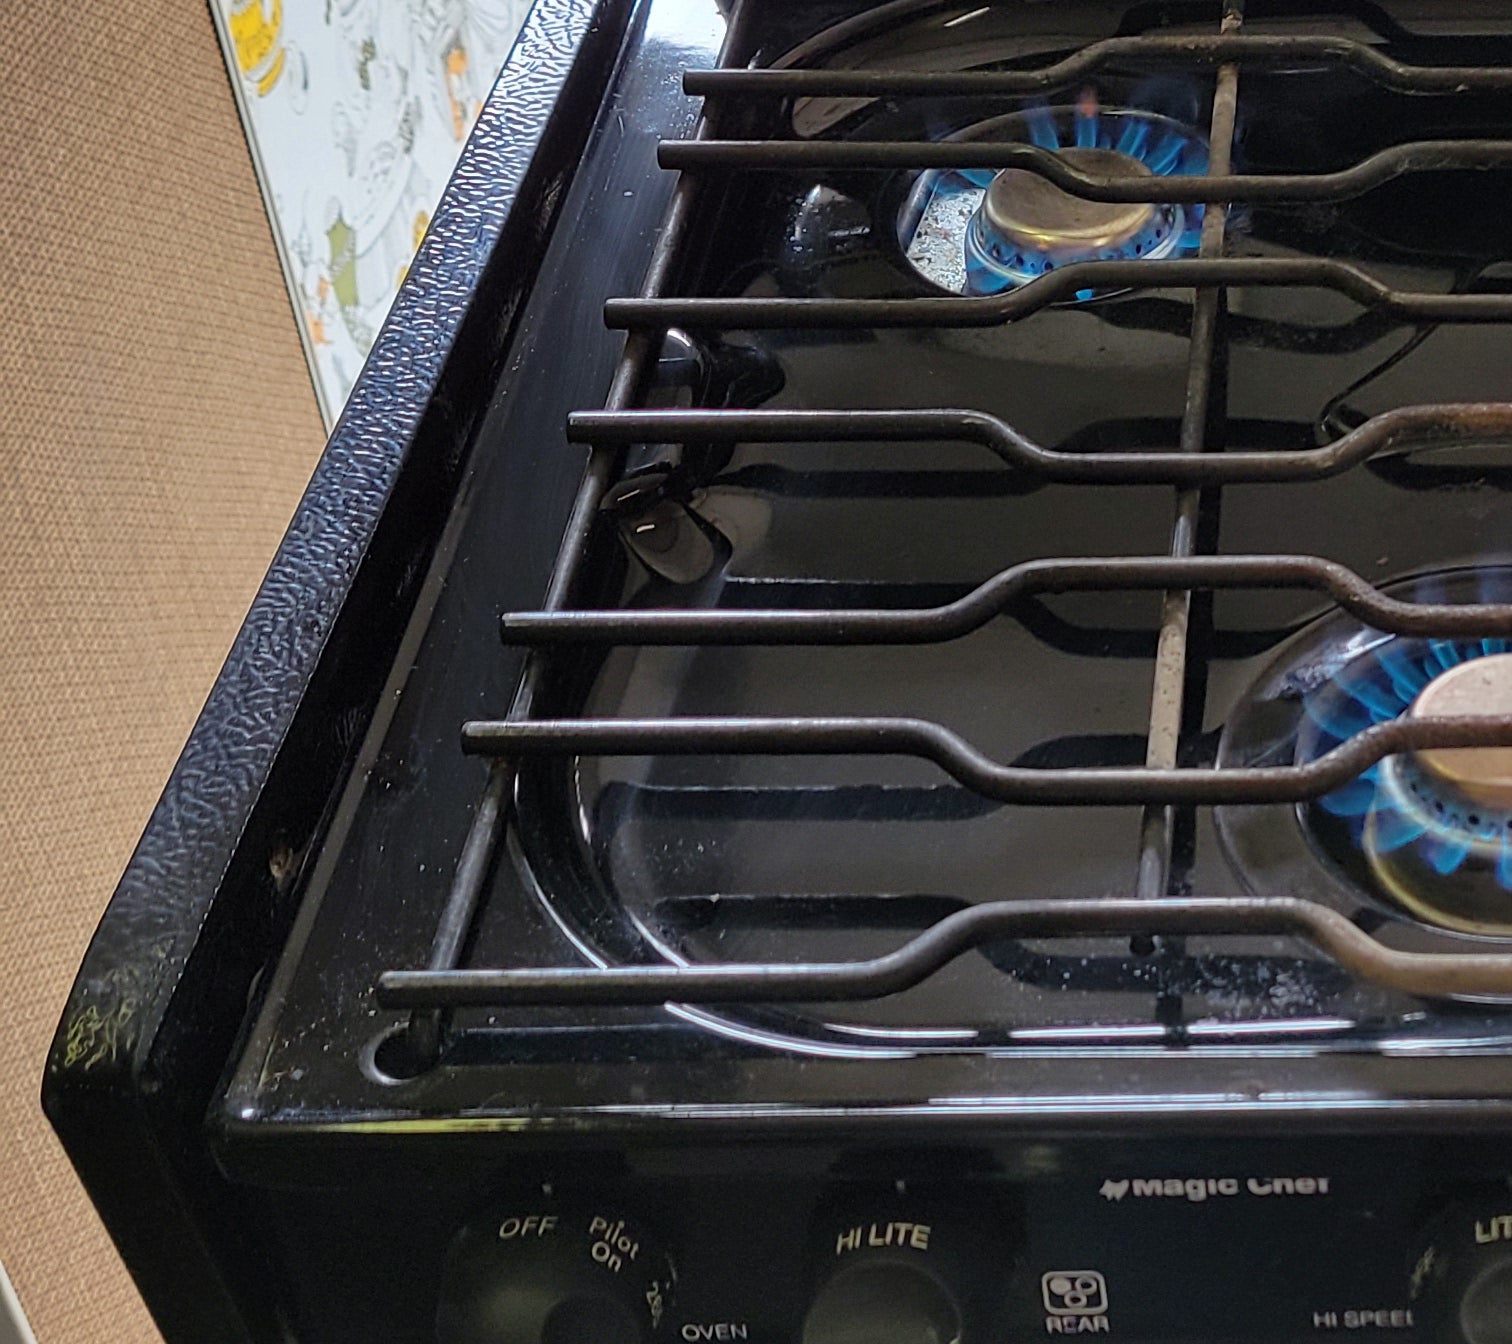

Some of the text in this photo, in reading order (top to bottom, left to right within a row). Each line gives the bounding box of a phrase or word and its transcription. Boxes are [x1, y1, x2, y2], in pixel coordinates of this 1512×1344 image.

[1132, 1177, 1240, 1202] Magic
[499, 1215, 558, 1240] OFF
[588, 1216, 640, 1261] Pilot
[836, 1221, 932, 1256] HI LITE
[590, 1241, 622, 1273] On
[1045, 1314, 1110, 1335] REAR
[1312, 1309, 1415, 1329] HI SPEE
[681, 1322, 748, 1343] OVEN
